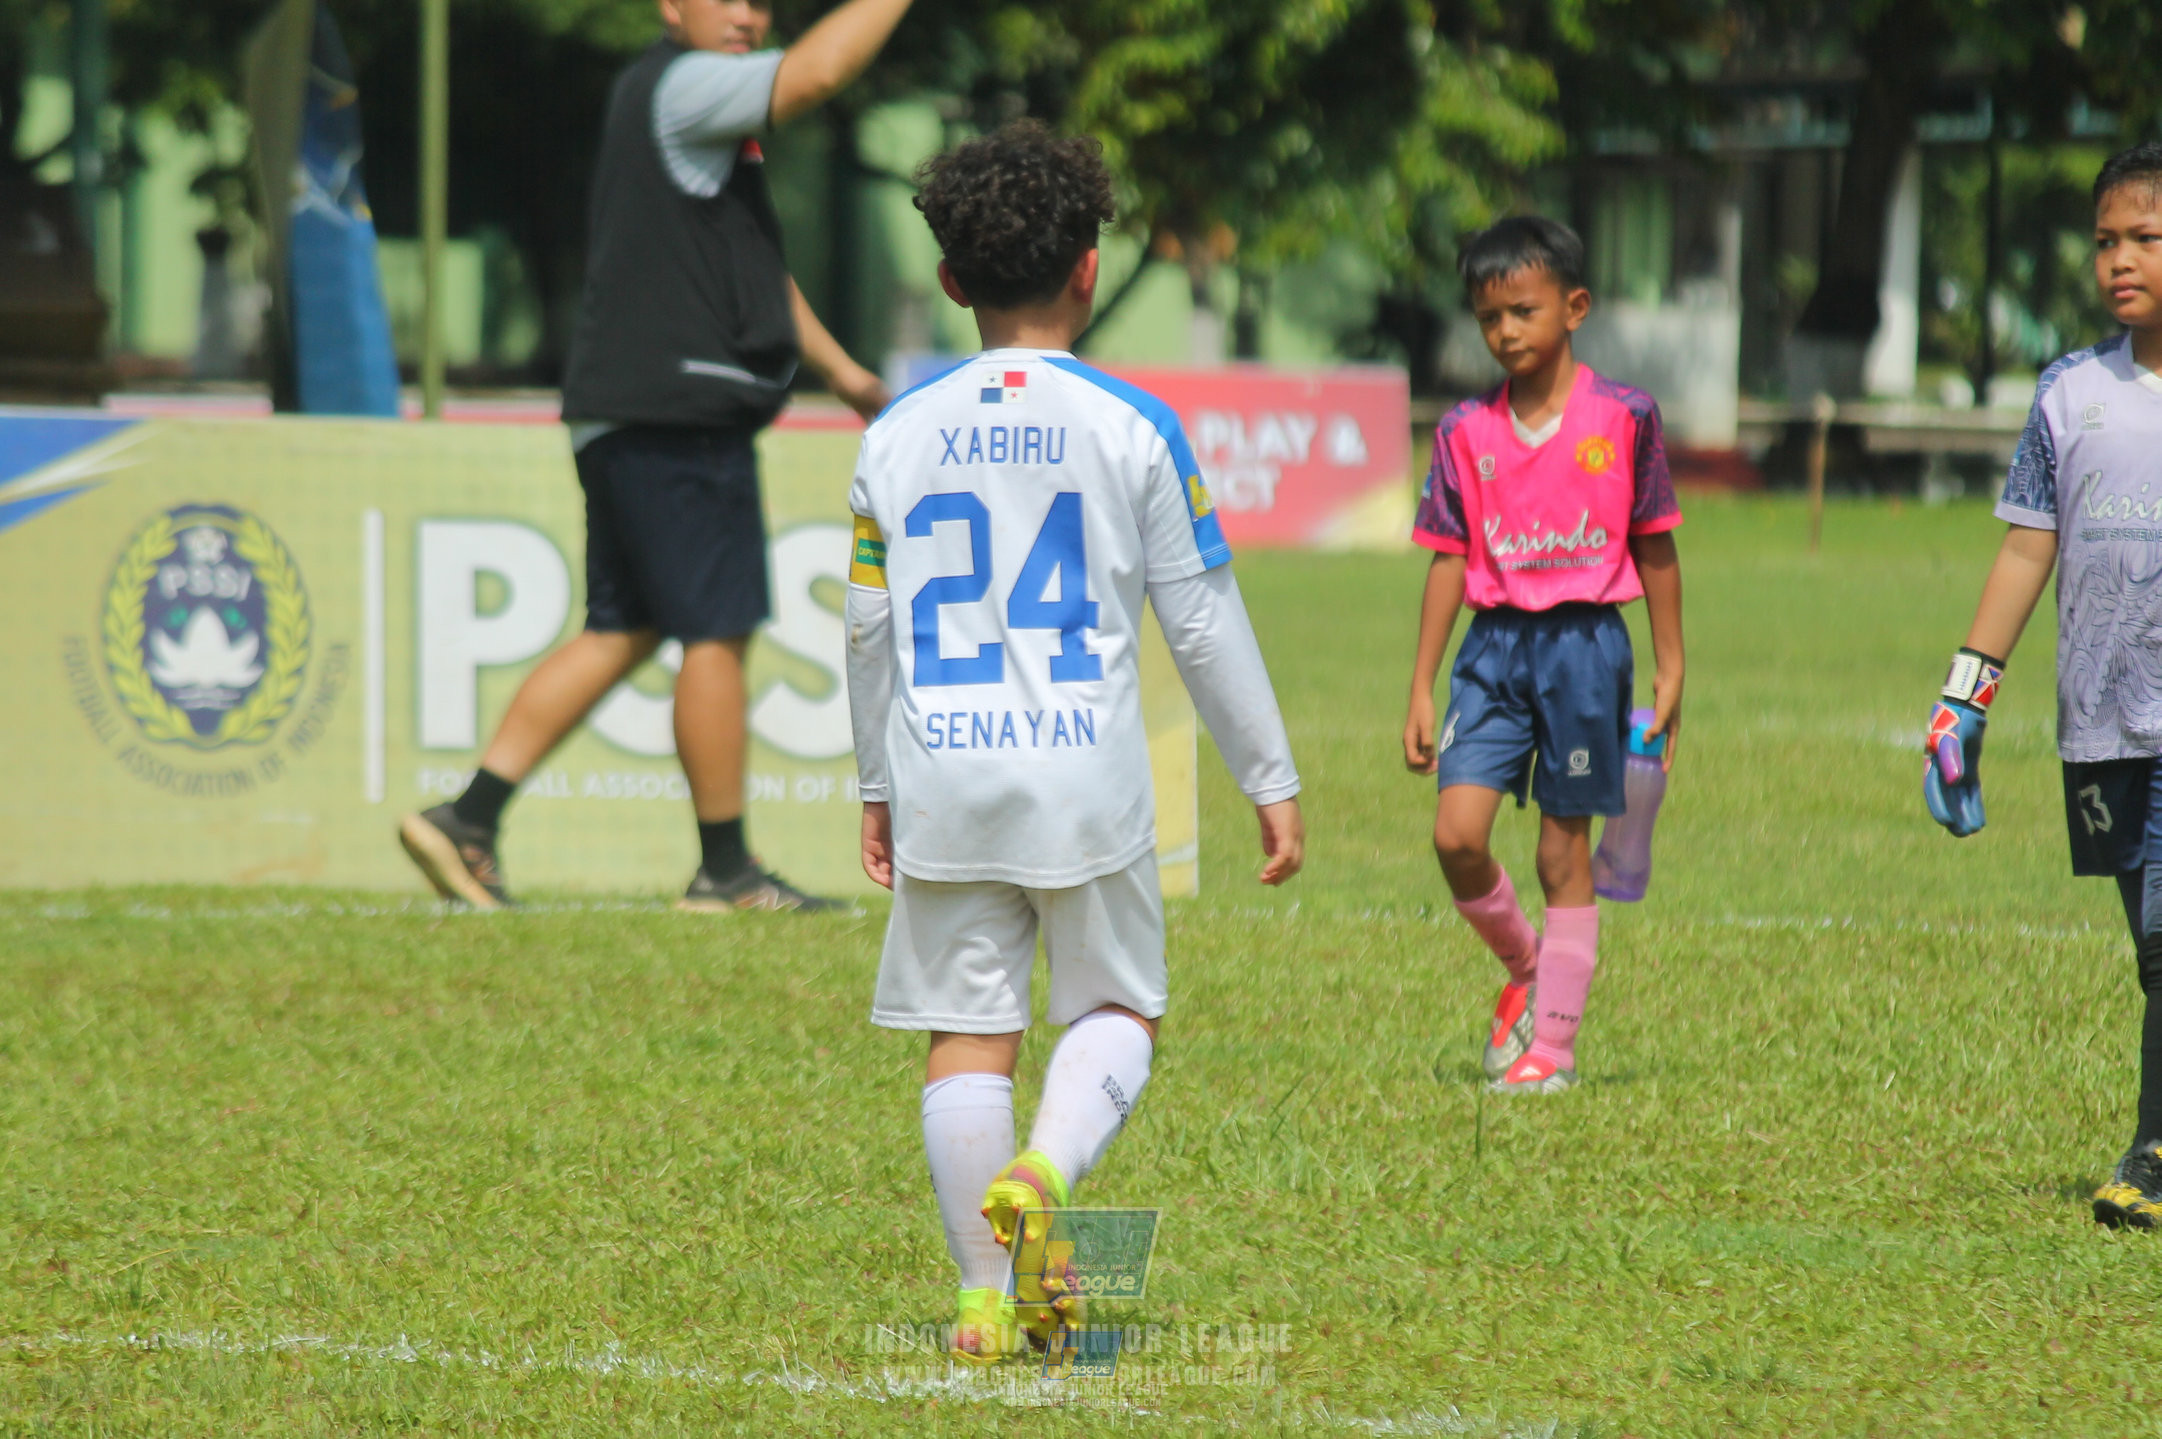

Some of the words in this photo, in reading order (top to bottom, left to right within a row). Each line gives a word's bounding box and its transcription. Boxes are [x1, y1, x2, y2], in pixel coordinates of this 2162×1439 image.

[939, 426, 1067, 466] XABIRU
[1484, 508, 1608, 556] Karindo
[158, 564, 252, 602] PSSI
[905, 491, 1104, 687] 24
[926, 710, 1097, 750] SENAYAN
[797, 775, 838, 802] OF
